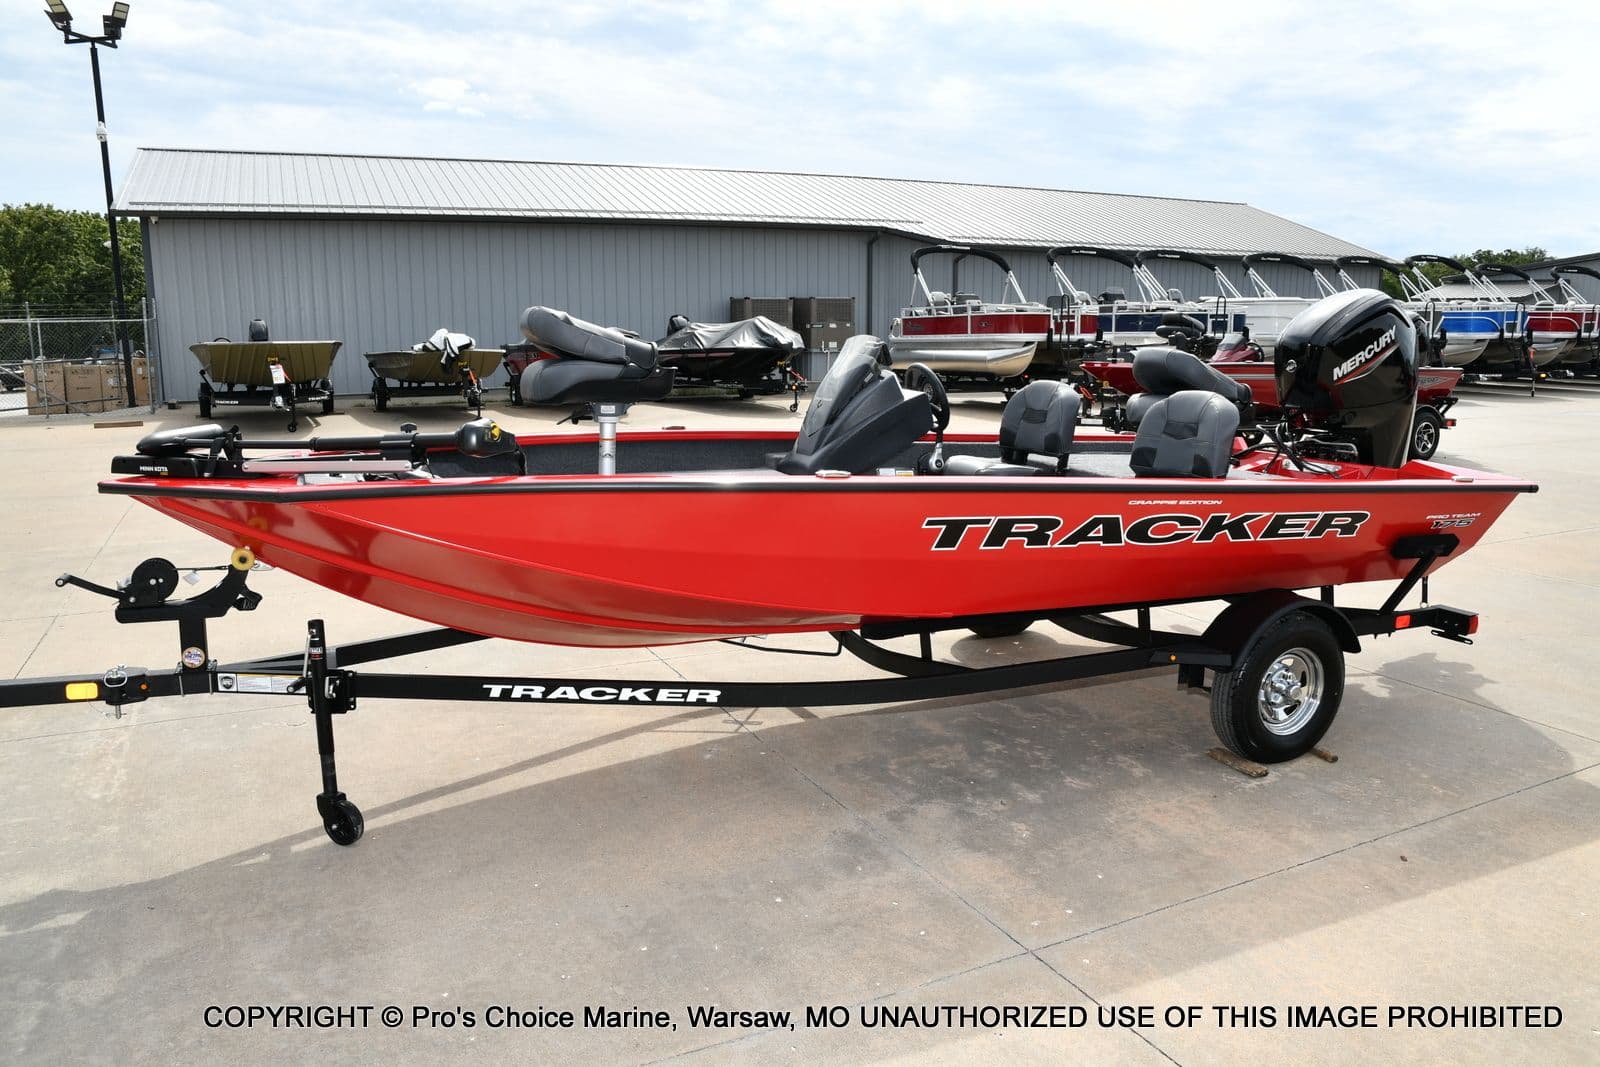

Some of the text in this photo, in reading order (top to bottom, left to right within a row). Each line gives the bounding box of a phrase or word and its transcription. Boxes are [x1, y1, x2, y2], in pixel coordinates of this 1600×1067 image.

[1332, 325, 1397, 381] MERCURY
[921, 510, 1371, 551] TRACKER
[1430, 518, 1476, 530] 175
[482, 684, 722, 703] TRACKER
